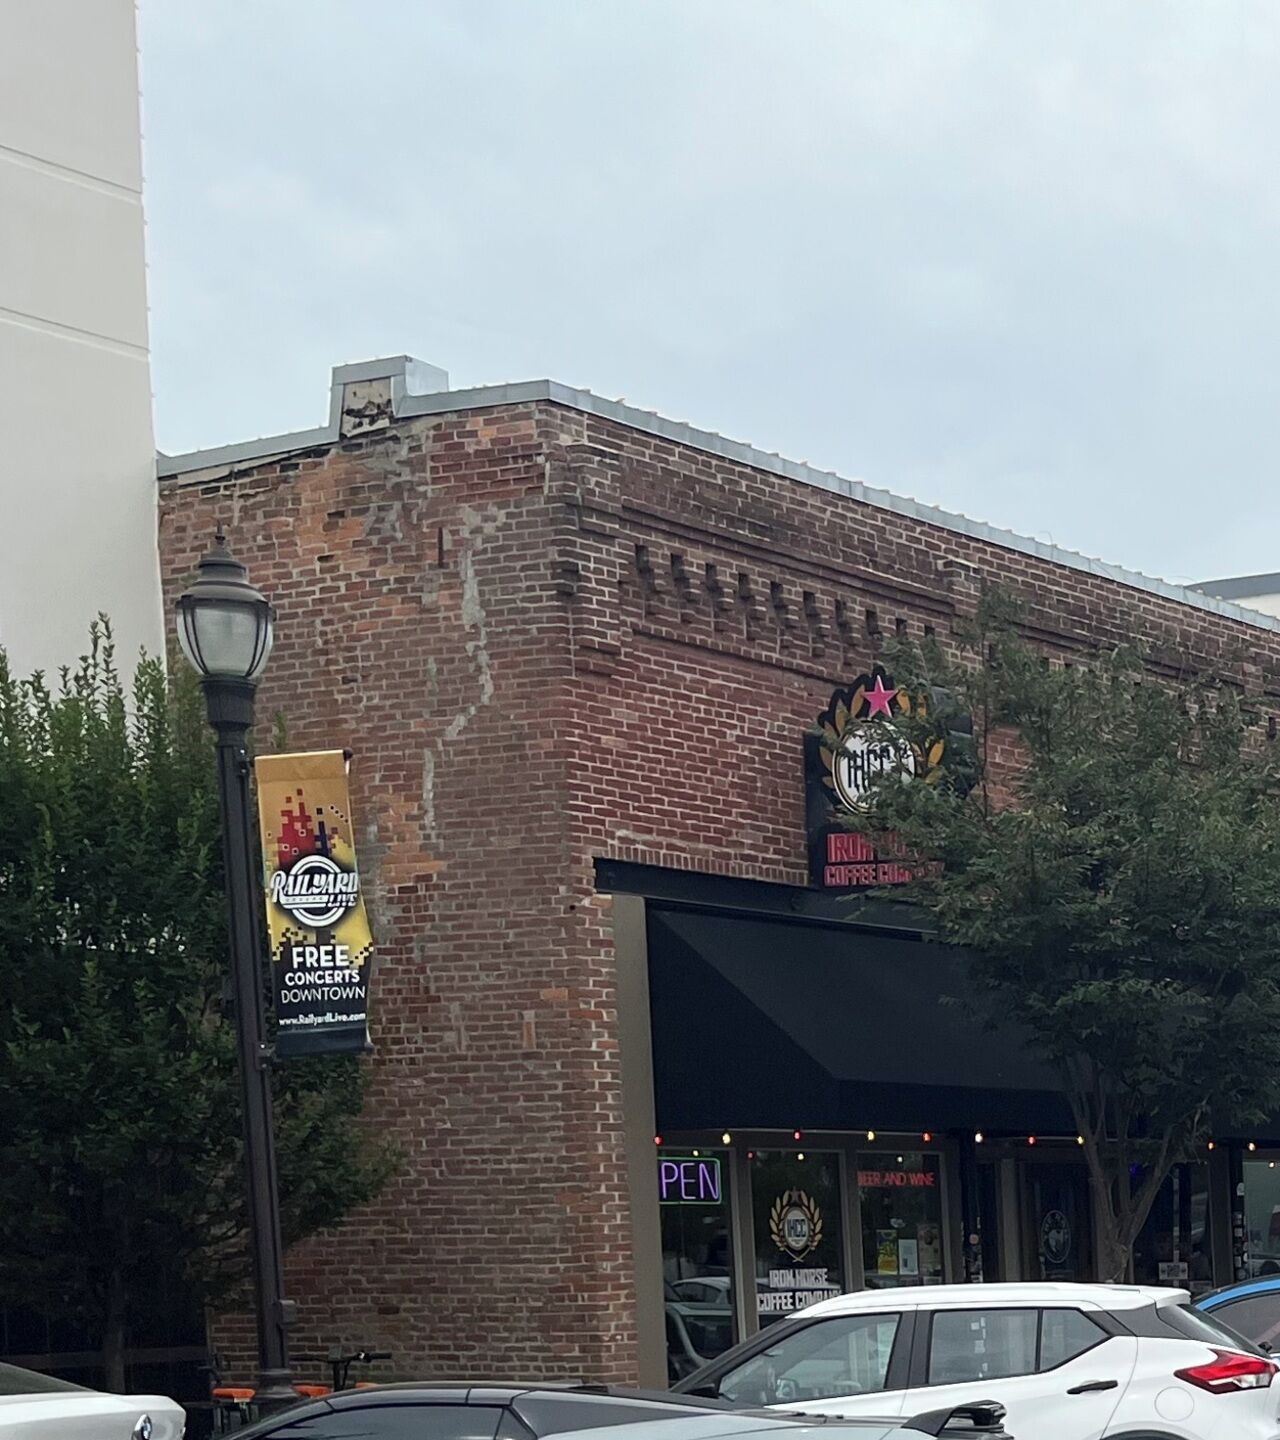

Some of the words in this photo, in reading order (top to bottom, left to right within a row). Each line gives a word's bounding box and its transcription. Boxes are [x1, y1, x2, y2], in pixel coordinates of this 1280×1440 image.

[827, 833, 874, 862] IRON
[824, 864, 876, 887] COFFEE
[270, 870, 359, 903] RAILYARD
[328, 893, 358, 908] LIVE
[292, 945, 350, 968] FREE
[285, 969, 360, 986] CONCERTS
[281, 985, 366, 1003] DOWNTOWN
[279, 1012, 366, 1026] www.RailyardLive.com
[661, 1162, 719, 1199] PEN
[884, 1172, 906, 1186] AND
[910, 1172, 935, 1187] WINE
[769, 1269, 793, 1289] IRON
[795, 1268, 828, 1288] HORSE
[757, 1292, 794, 1311] COFFEE
